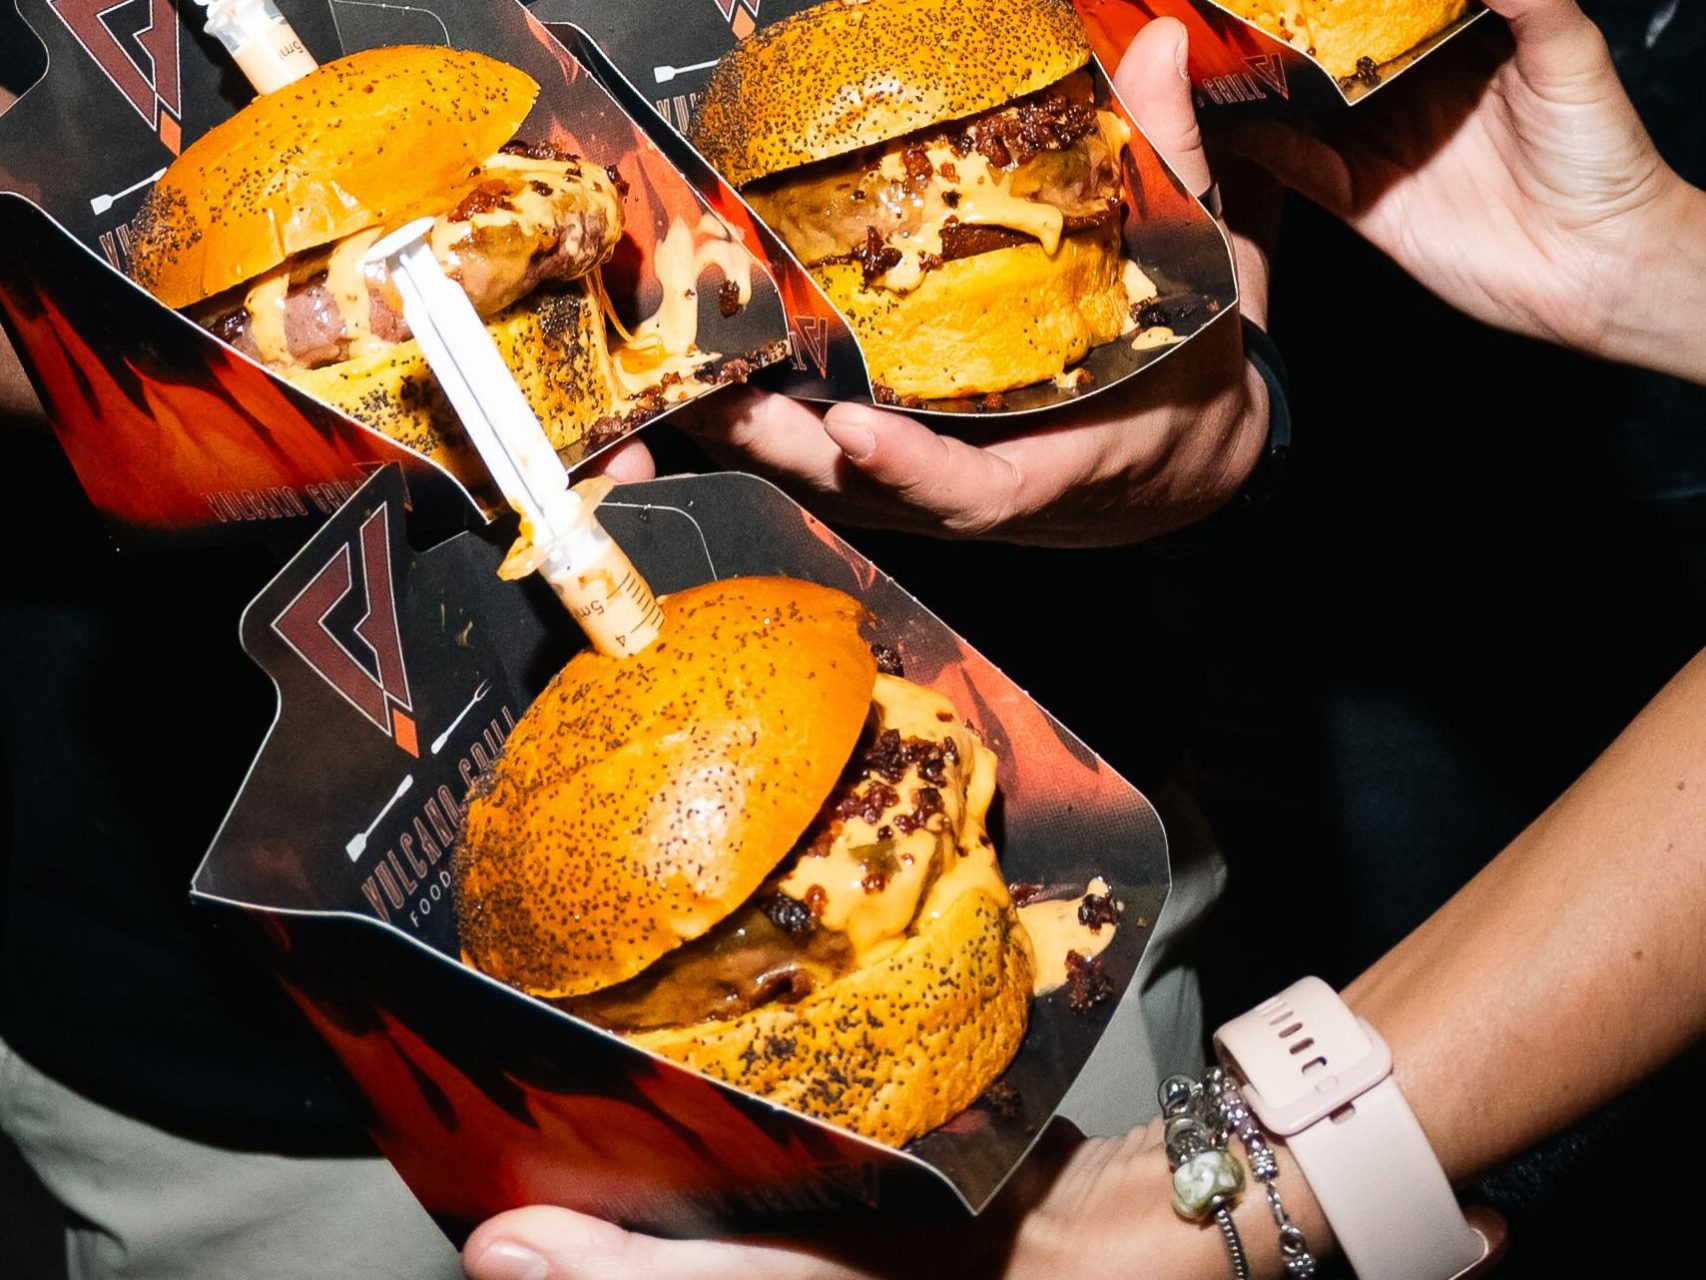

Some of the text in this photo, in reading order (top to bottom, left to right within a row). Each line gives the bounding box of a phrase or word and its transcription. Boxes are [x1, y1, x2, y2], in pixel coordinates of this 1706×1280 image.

[206, 479, 363, 523] VULCANO GRI
[360, 784, 469, 923] VULCANO
[409, 870, 453, 928] FOOD
